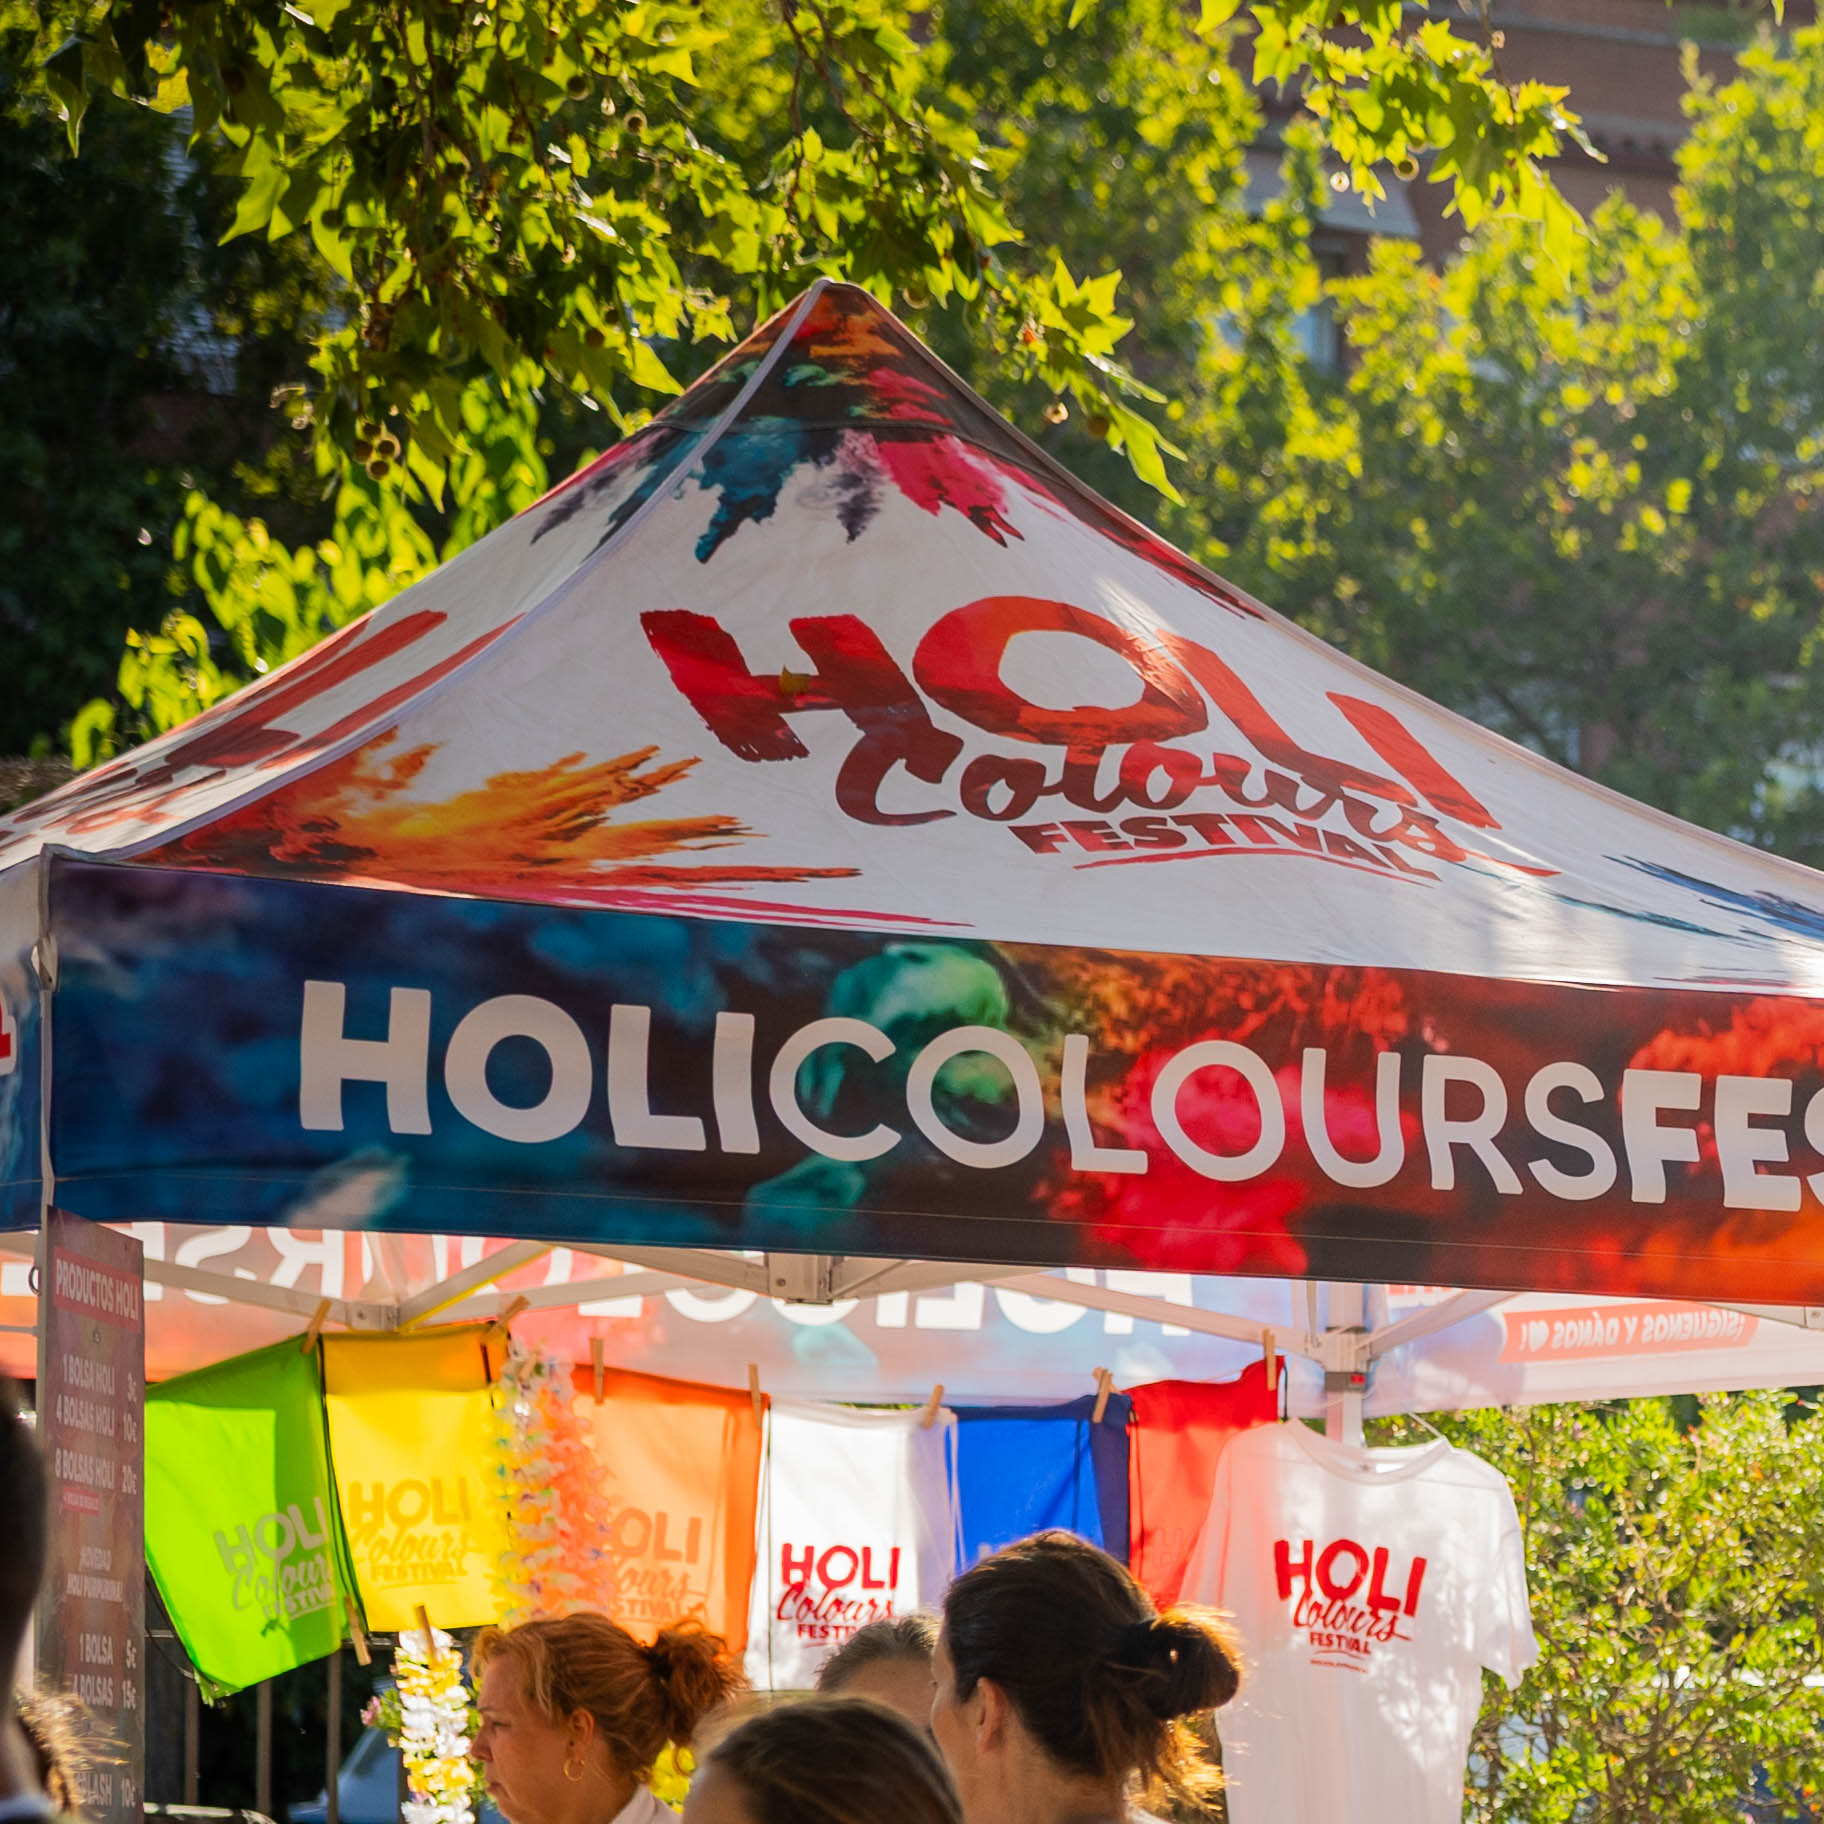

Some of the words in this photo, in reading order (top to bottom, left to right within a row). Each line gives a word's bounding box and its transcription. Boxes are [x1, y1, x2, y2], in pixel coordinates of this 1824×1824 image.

[639, 595, 1502, 830] HOLI
[836, 721, 1562, 876] Colours
[1008, 813, 1441, 881] FESTIVAL
[56, 1258, 114, 1313] PRODUCTOS
[115, 1279, 139, 1321] HOLI
[68, 1356, 95, 1391] BOLSA
[95, 1363, 115, 1396] HOLI
[56, 1394, 62, 1423] 4
[63, 1396, 94, 1433] BOLSAS
[95, 1404, 115, 1437] HOLI
[63, 1449, 93, 1485] BOLSAS
[95, 1458, 115, 1490] HOLI
[349, 1478, 472, 1529] HOLI
[214, 1496, 329, 1576] HOLI
[612, 1507, 702, 1565] OLI
[370, 1561, 468, 1582] FESTIVAL
[781, 1543, 900, 1590] HOLI
[1274, 1538, 1427, 1617] HOLI
[85, 1632, 113, 1666] BOLSA
[1310, 1631, 1371, 1655] FESTIVAL
[80, 1674, 113, 1708] BOLSAS
